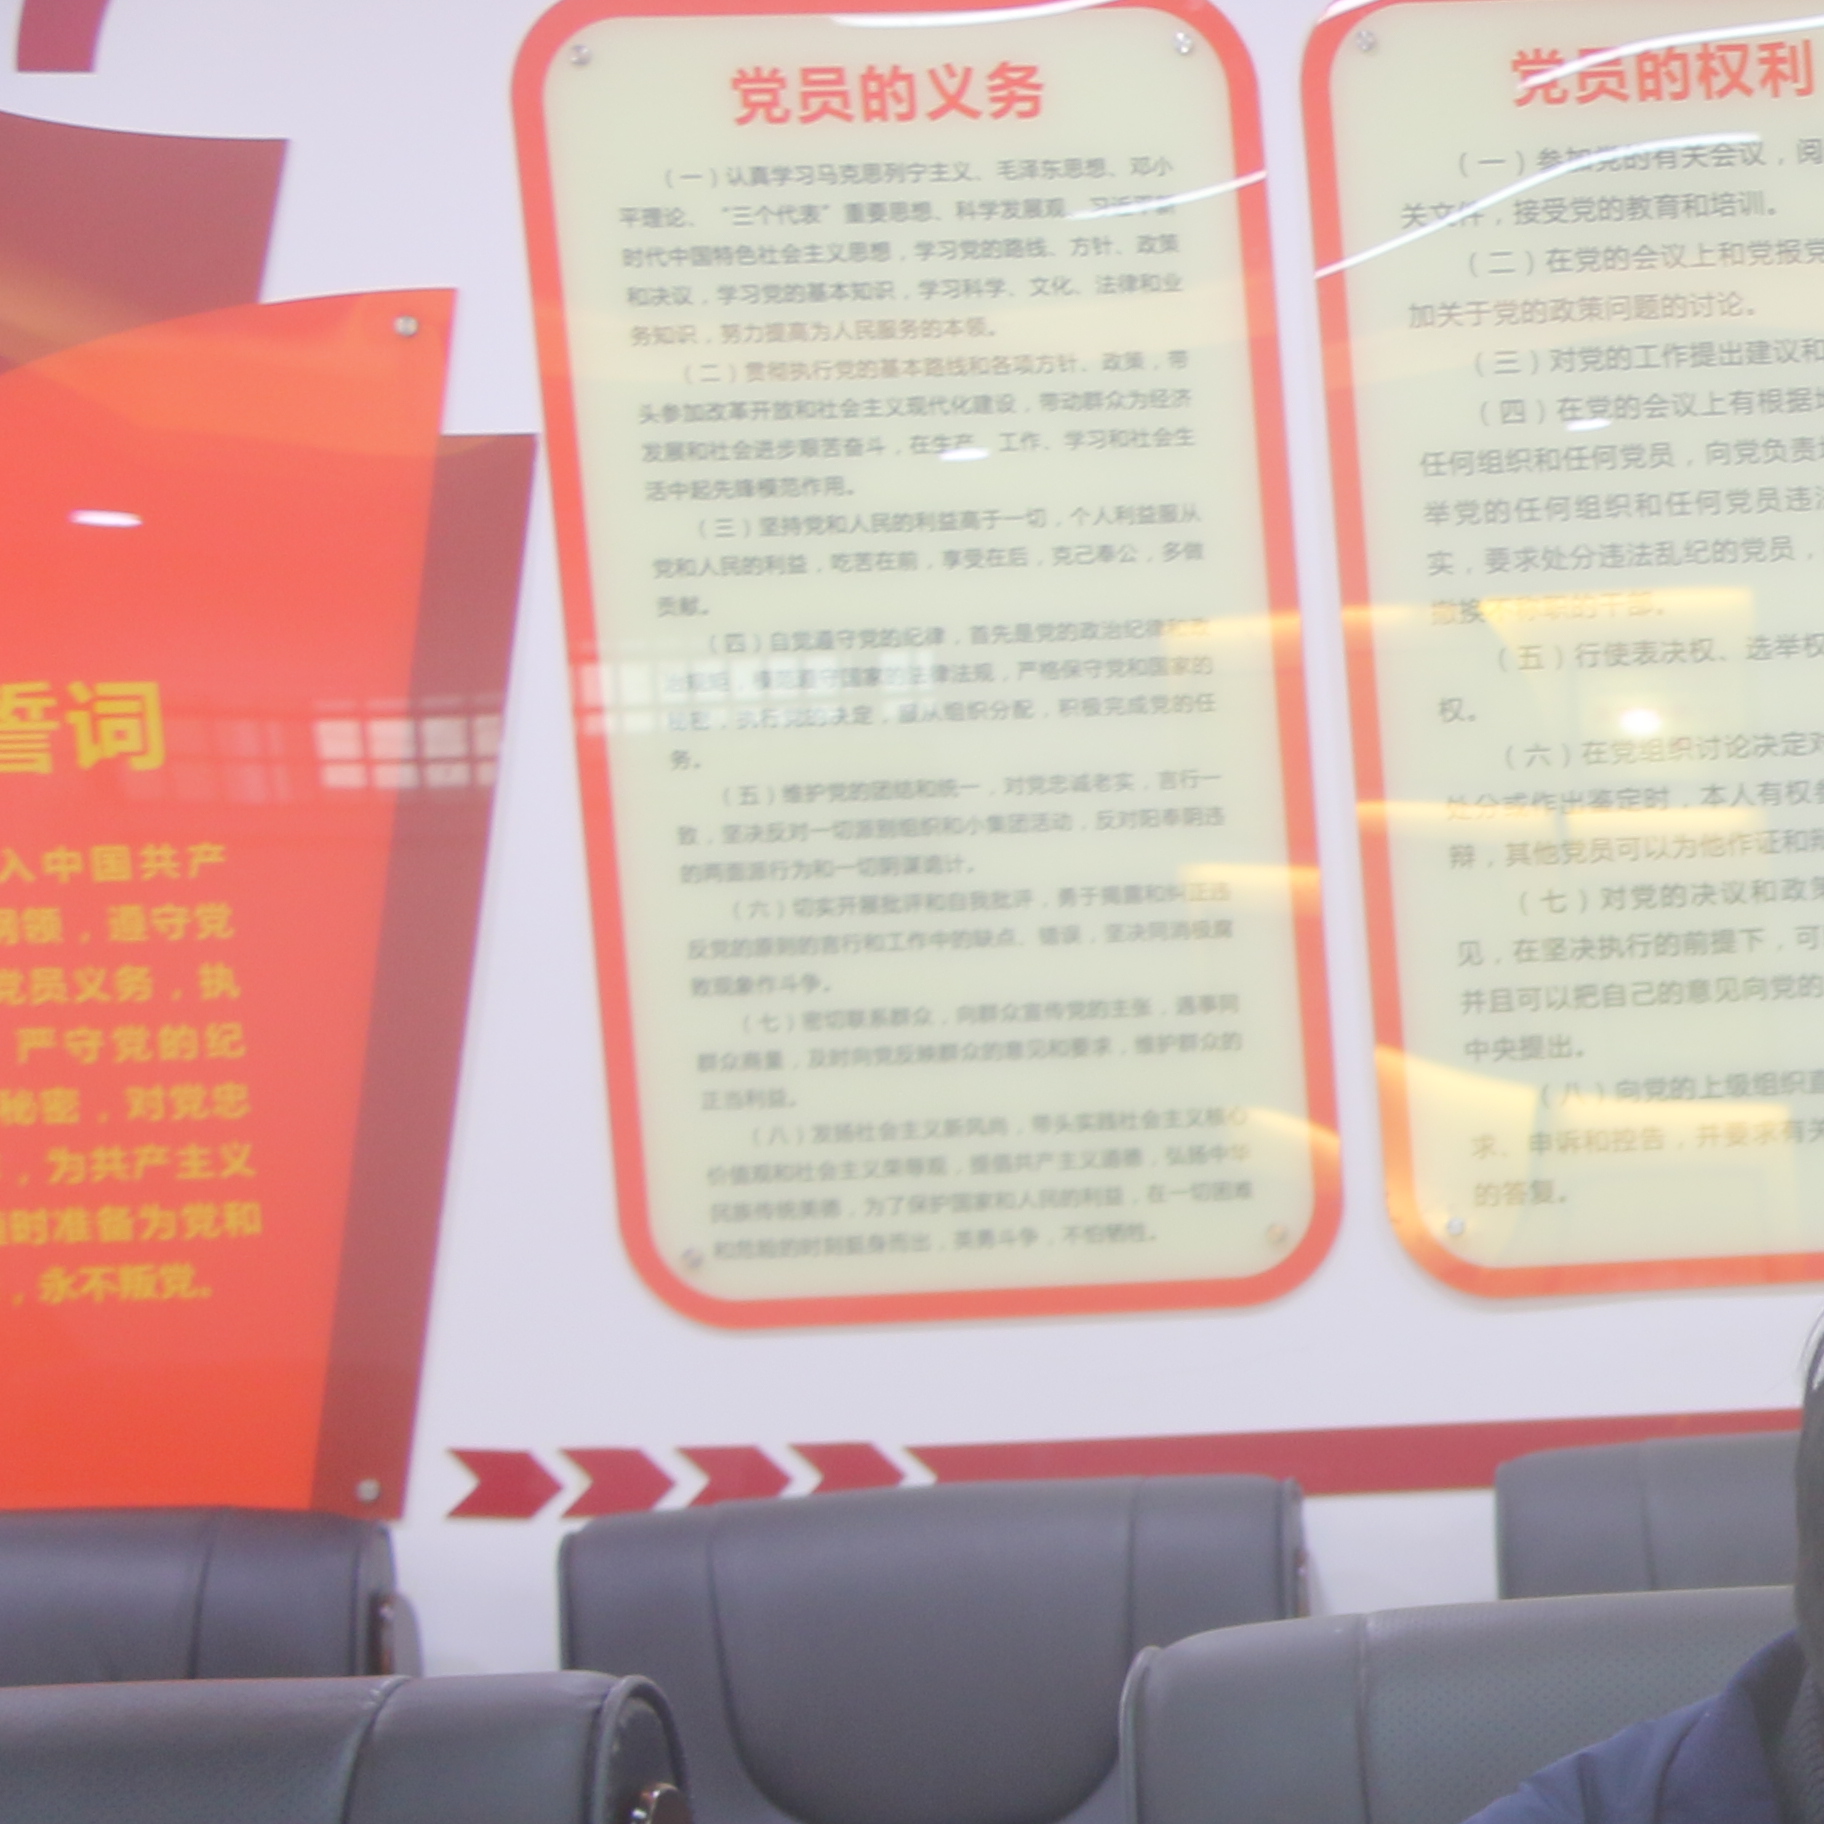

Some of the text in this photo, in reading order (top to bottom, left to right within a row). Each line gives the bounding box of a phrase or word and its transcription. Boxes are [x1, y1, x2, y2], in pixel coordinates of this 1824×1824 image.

[1511, 39, 1816, 107] 党员的权利
[731, 62, 1046, 127] 党员的义务
[665, 157, 1173, 186] （一）认真学习马克思列宁主义、毛泽东思想、邓小
[1400, 192, 1776, 227] 关文件，接受党的教育和培训。
[622, 236, 1178, 267] 时代中国特色社会主义思想，学习党的路线、方针、政策
[626, 275, 1181, 305] 和决议，学习党的基本知识，学习科学、文化、法律和业
[1408, 292, 1754, 327] 加关于党的政策问题的讨论。
[631, 318, 994, 345] 务知识，努力提高为人民服务的本领。
[641, 428, 1194, 461] 发展和社会进步艰苦奋斗，在生产工作、学习和社会生
[657, 596, 708, 616] 贡献。
[1439, 697, 1475, 722] 权。
[0, 680, 165, 774] 誓词
[671, 749, 700, 769] 务。
[0, 842, 226, 883] 入中国共产
[1465, 1034, 1583, 1062] 中央提出。
[1476, 1179, 1565, 1206] 的答复。
[0, 1200, 262, 1246] 时准备为党和
